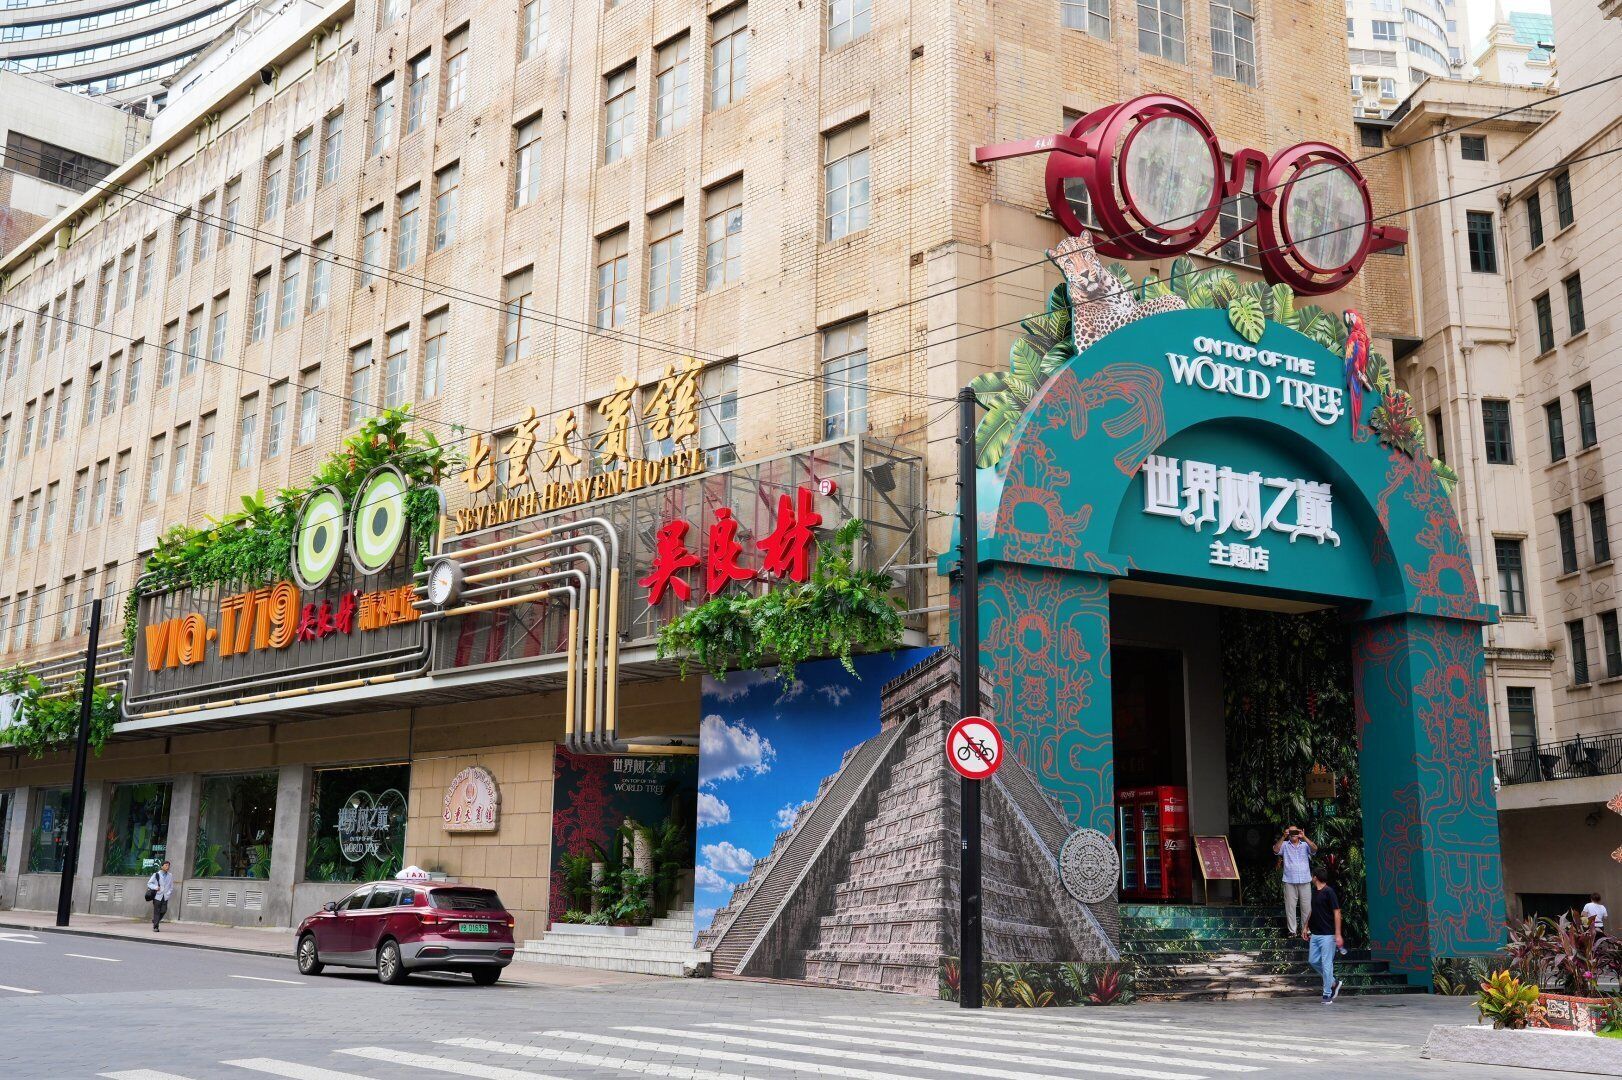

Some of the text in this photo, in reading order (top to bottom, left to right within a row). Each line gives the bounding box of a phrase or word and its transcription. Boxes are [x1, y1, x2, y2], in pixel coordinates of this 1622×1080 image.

[1165, 352, 1344, 426] WORLD TREE
[1193, 336, 1316, 377] ON TOP OF THE
[455, 448, 706, 535] SEVENTH HEAVEN HOTEL
[1140, 454, 1341, 548] 世界树之巅
[638, 486, 822, 607] 吴良材
[1209, 540, 1270, 572] 主题店
[614, 783, 643, 792] WORLD
